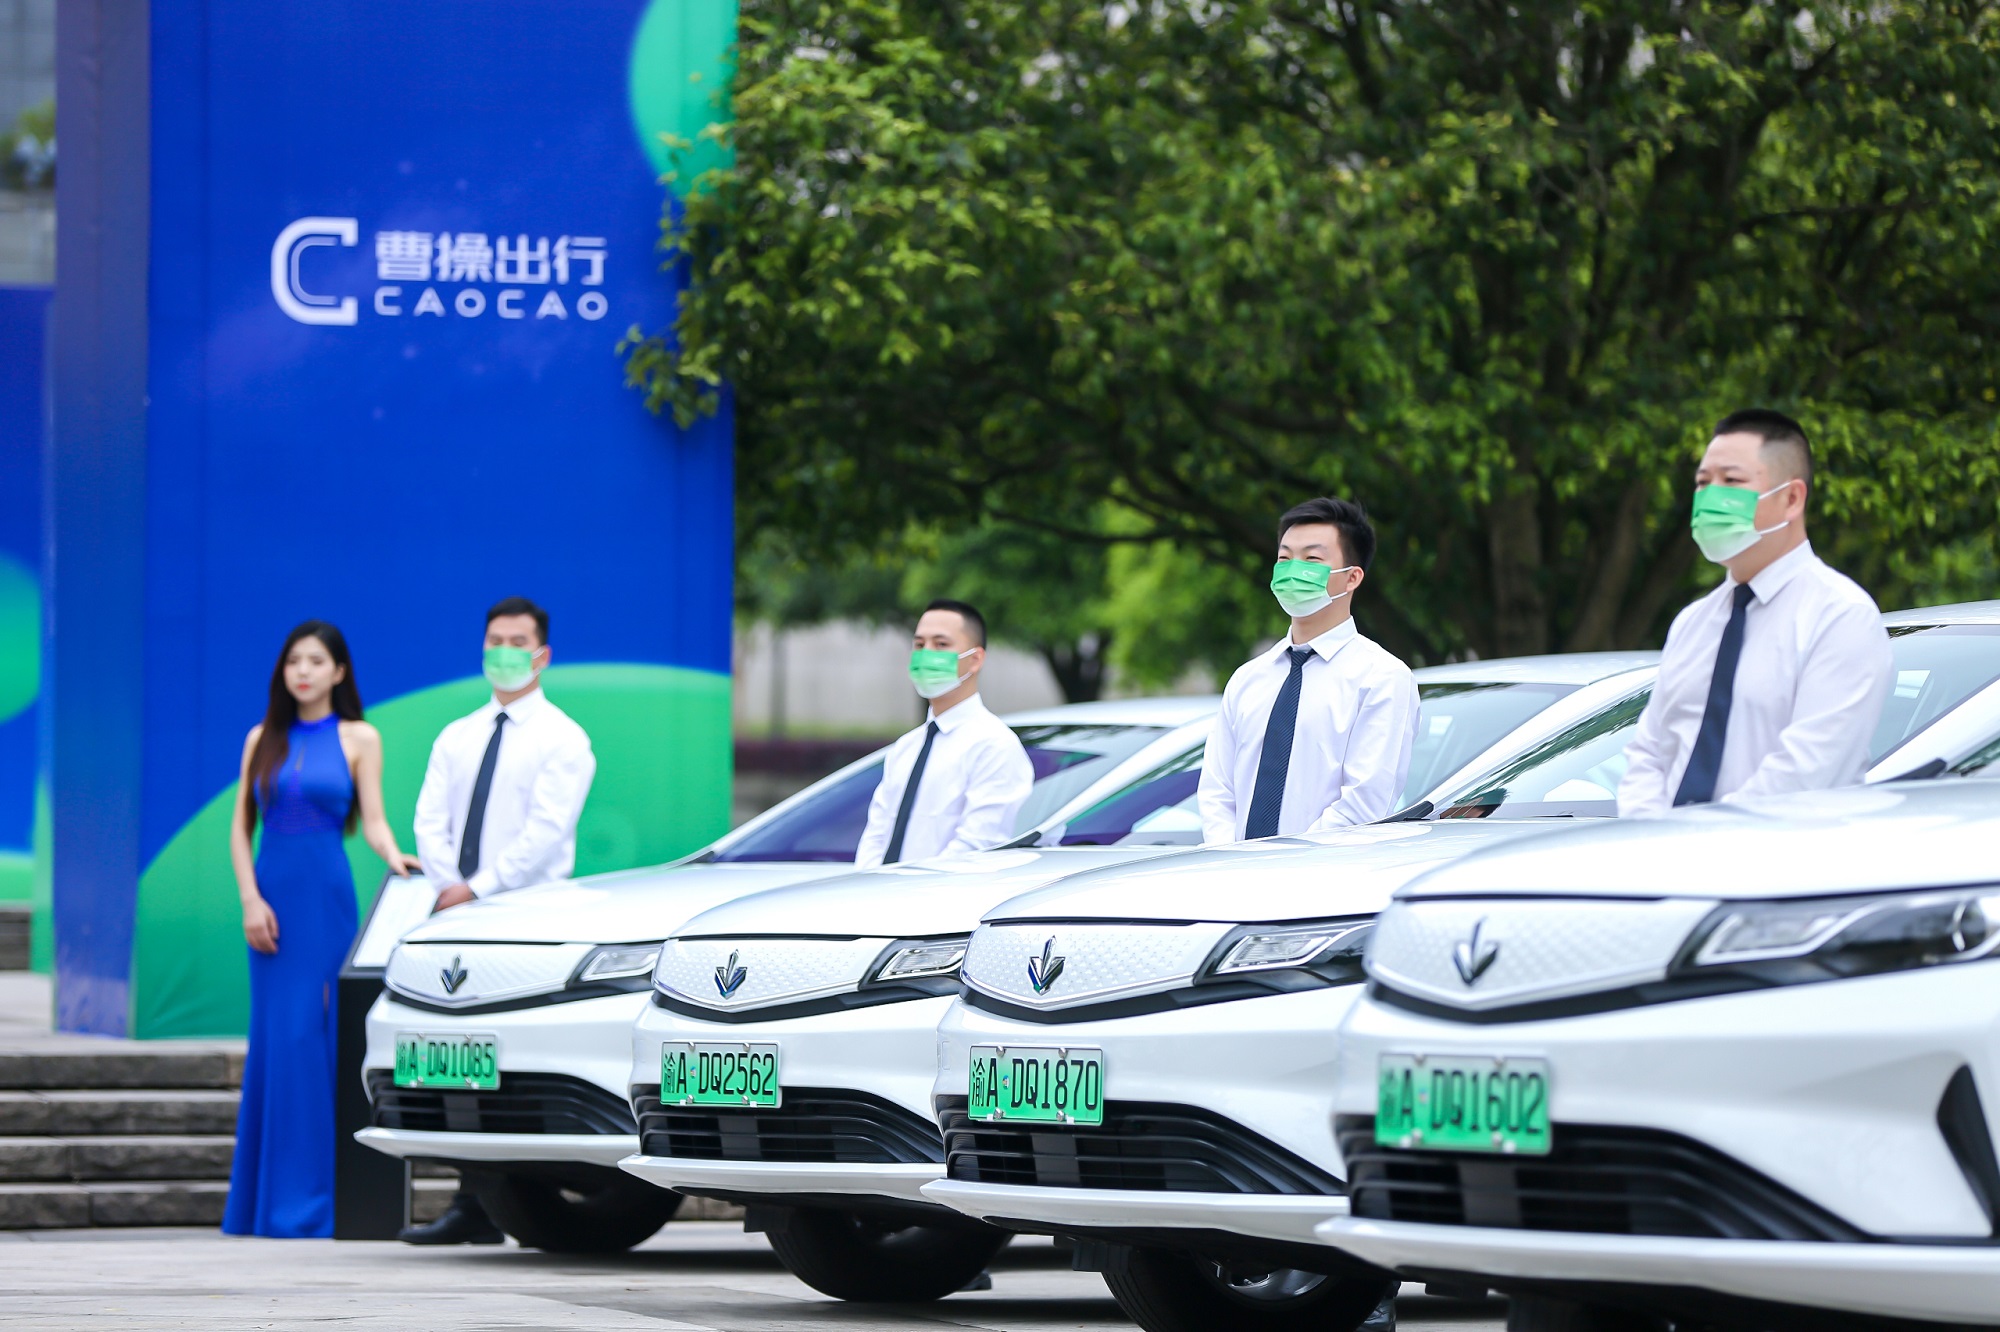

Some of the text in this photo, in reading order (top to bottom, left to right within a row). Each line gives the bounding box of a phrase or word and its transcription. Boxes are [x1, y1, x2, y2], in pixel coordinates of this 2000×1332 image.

[374, 230, 608, 285] 曹操出行
[374, 286, 609, 321] CAOCAO
[698, 1051, 774, 1096] DQ2562
[1010, 1058, 1099, 1111] DQ1870
